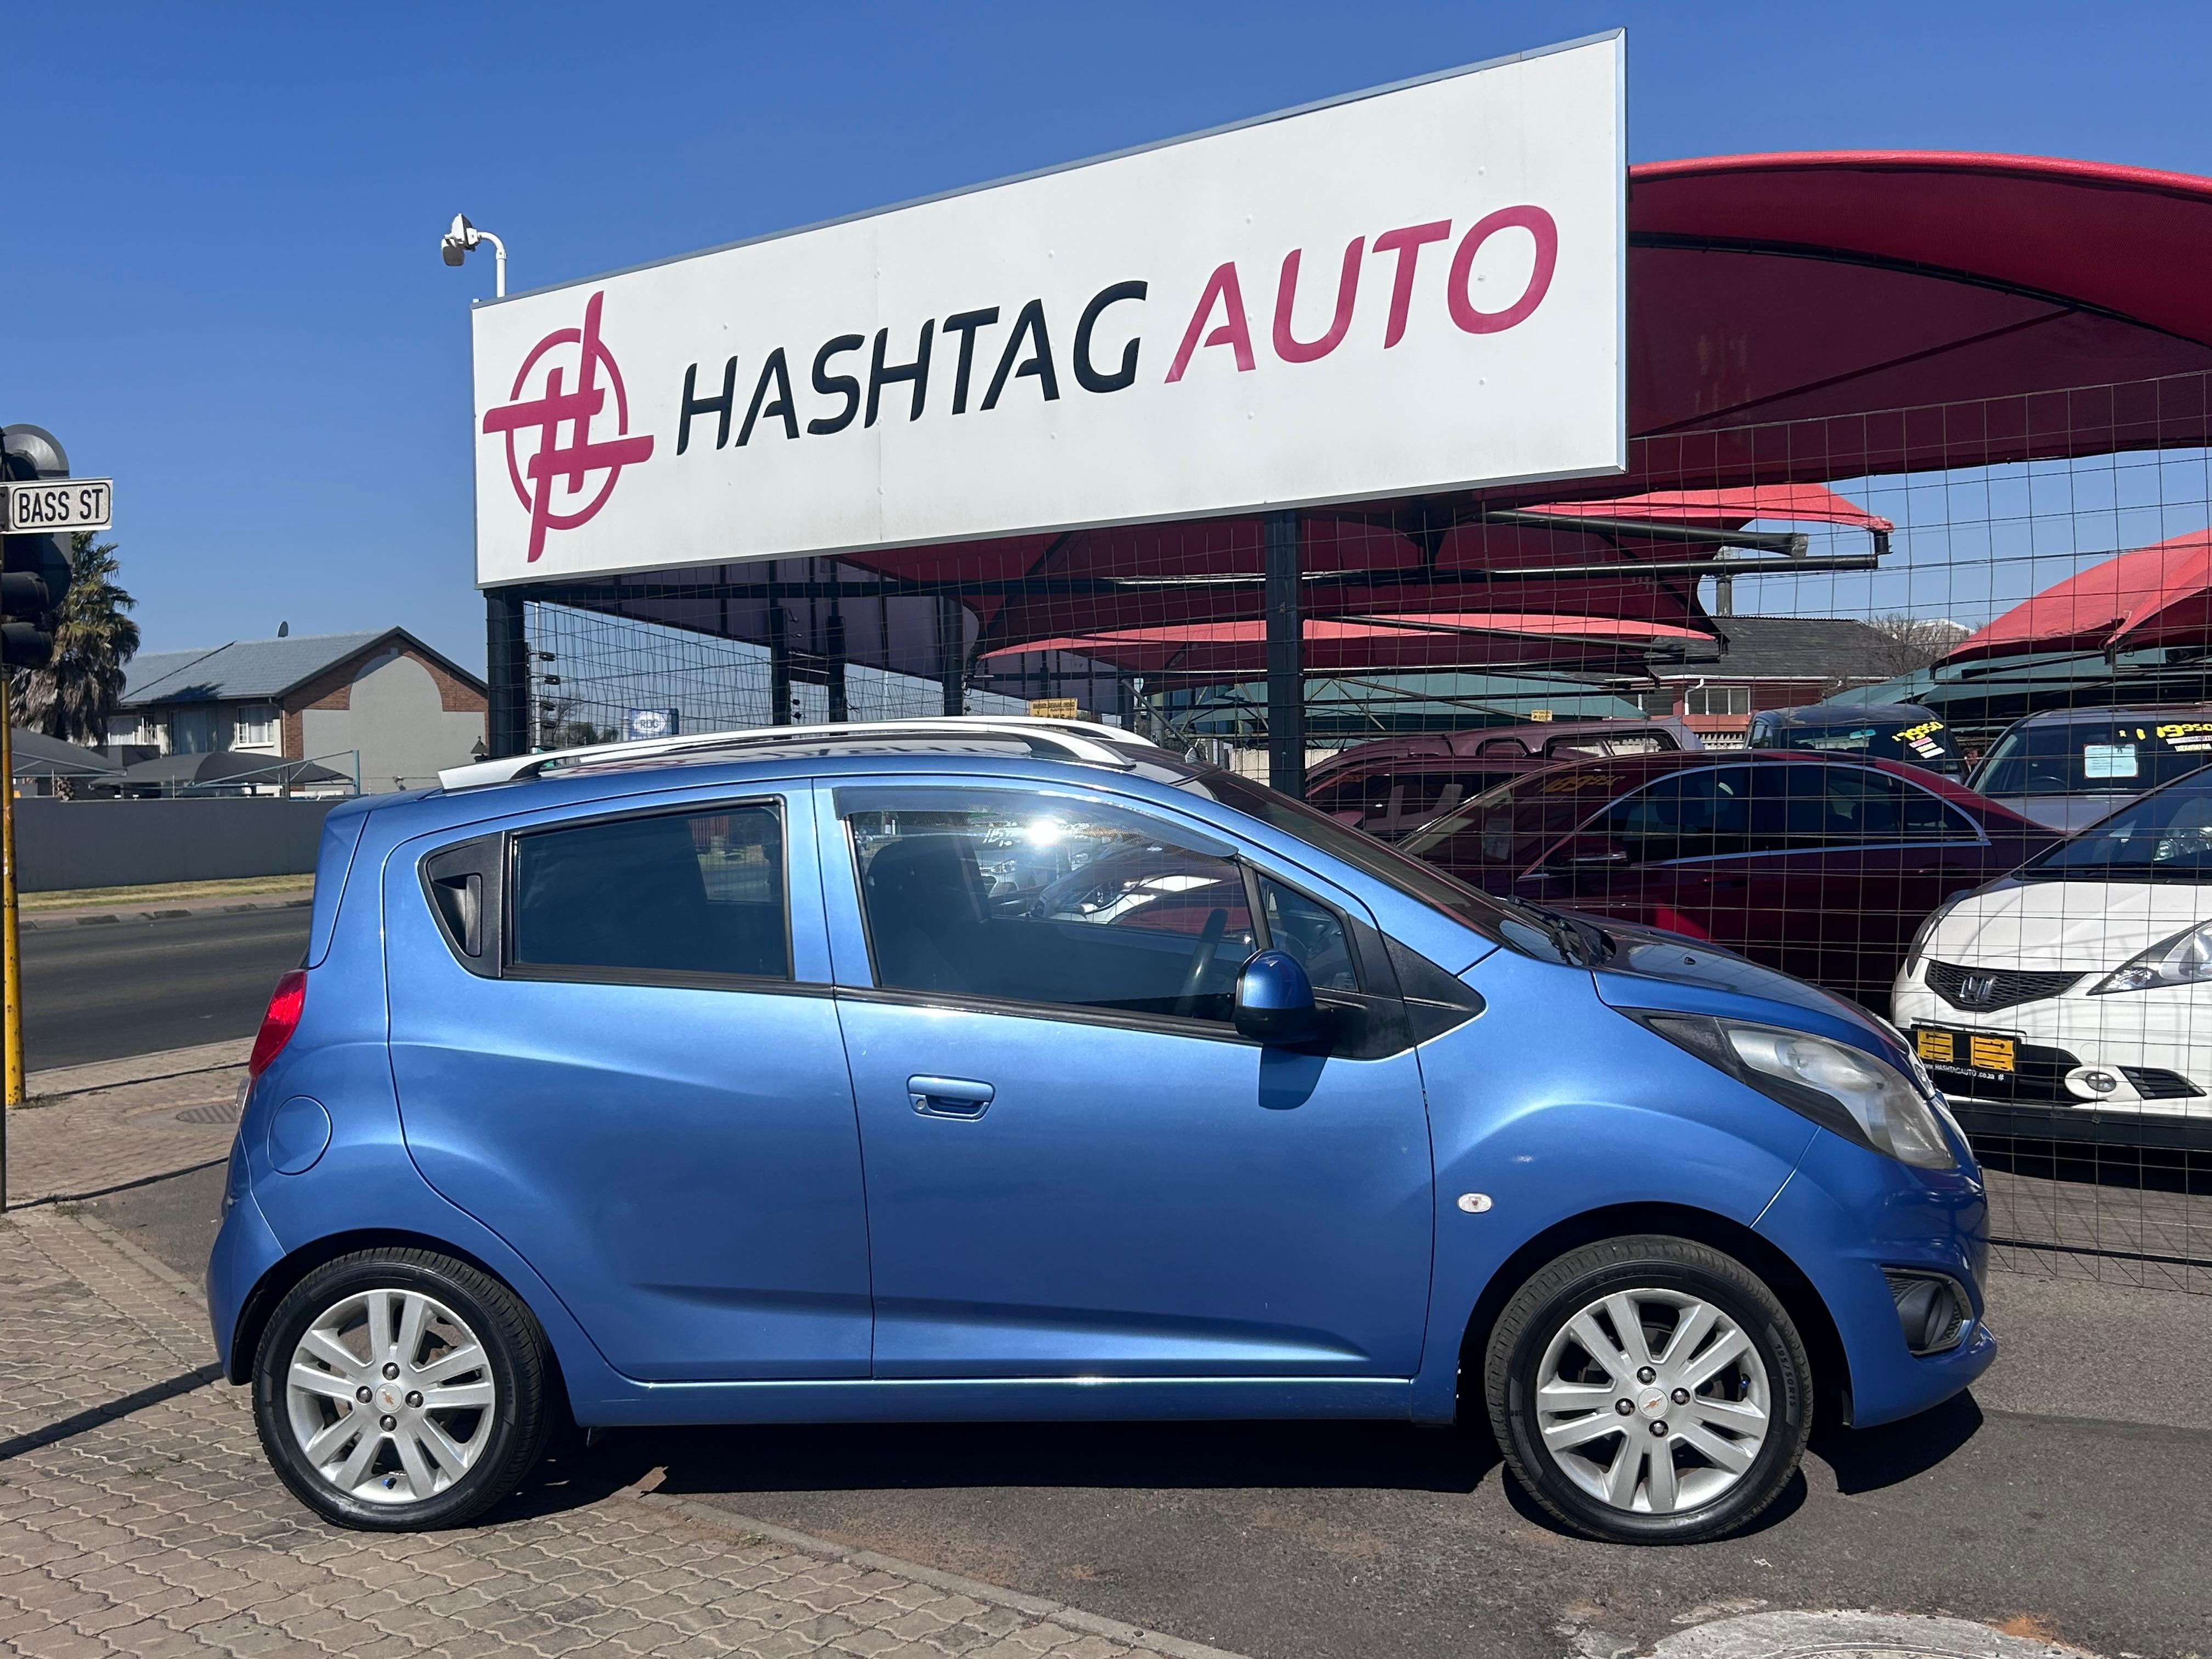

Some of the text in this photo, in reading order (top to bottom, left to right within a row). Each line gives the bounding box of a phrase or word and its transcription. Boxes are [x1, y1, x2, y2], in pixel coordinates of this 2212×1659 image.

[677, 205, 1558, 455] HASHTAG AUTO
[19, 488, 103, 523] BASS ST
[1775, 1344, 1796, 1407] 195/50R15
